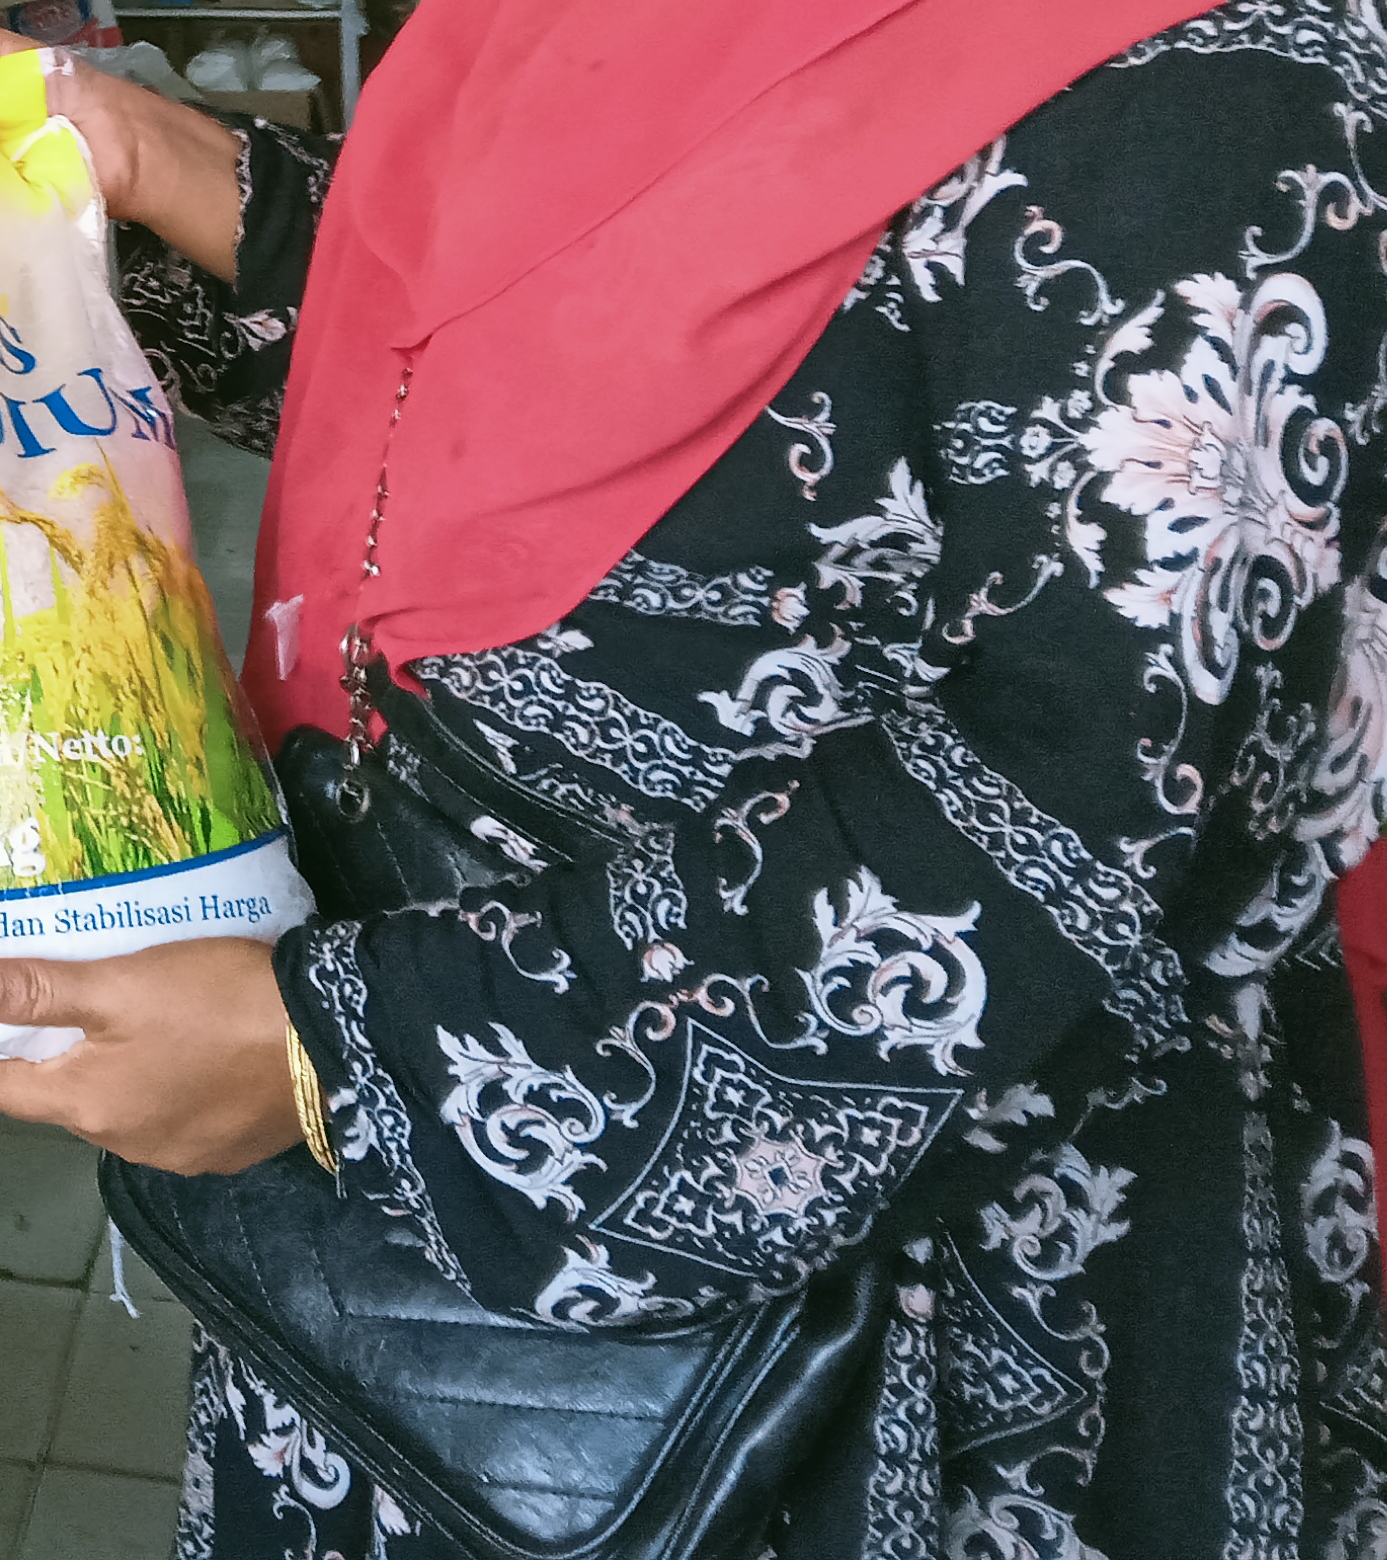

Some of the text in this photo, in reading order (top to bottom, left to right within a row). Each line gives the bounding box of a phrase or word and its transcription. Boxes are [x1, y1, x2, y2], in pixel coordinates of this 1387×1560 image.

[32, 728, 146, 765] Netto:
[54, 895, 193, 937] Stabilisasi
[200, 890, 273, 928] Harga
